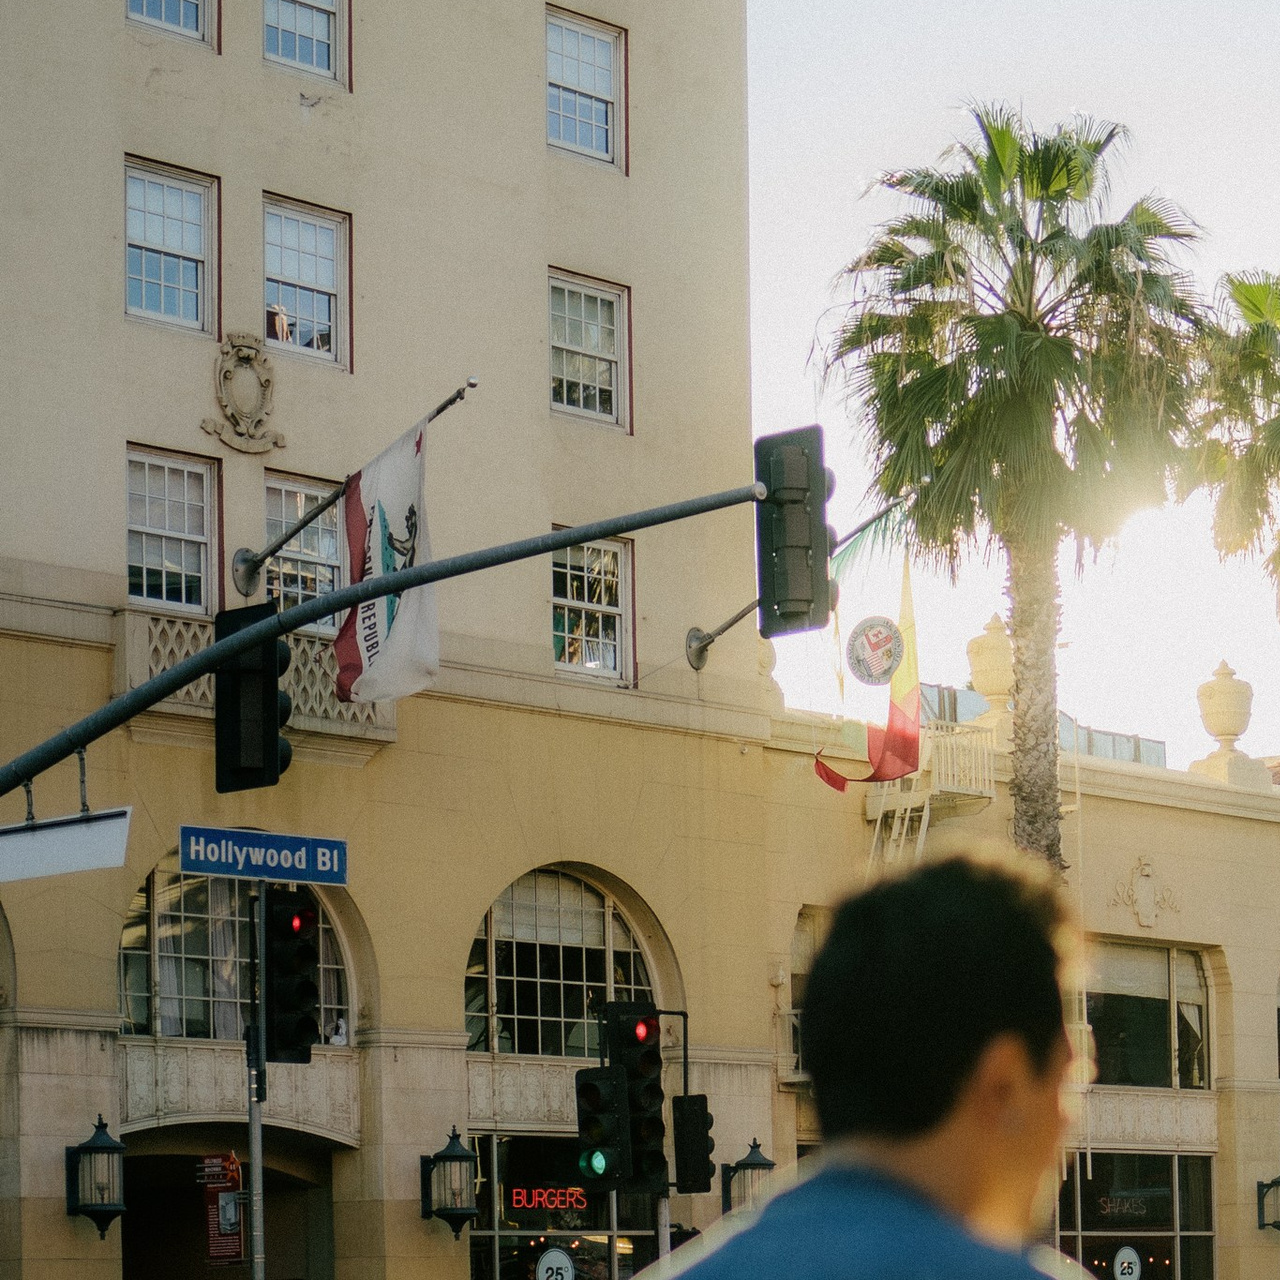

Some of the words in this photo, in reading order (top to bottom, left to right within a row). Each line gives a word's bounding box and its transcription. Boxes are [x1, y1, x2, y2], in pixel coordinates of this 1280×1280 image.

[189, 835, 307, 871] Hollywood
[316, 847, 340, 872] Bl
[512, 1187, 587, 1210] BURGERS
[1099, 1197, 1147, 1215] SHAKES
